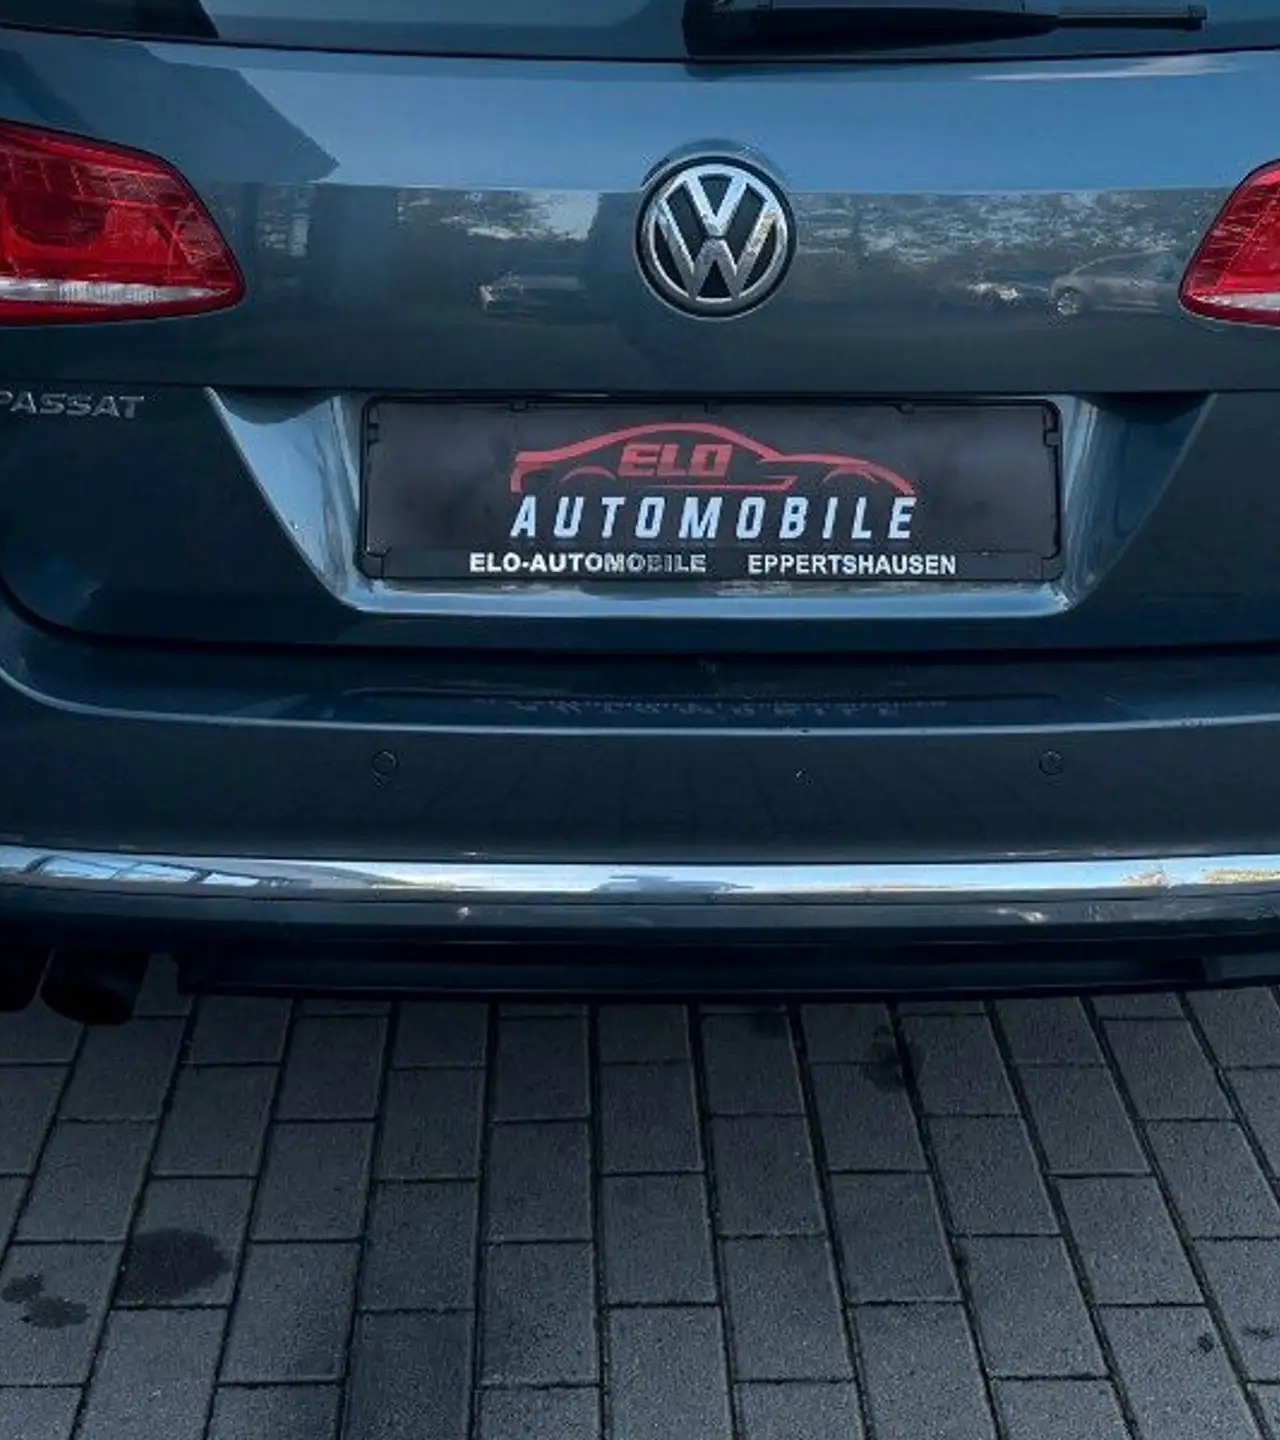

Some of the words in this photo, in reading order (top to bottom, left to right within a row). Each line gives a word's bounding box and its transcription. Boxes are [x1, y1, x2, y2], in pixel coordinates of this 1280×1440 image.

[646, 162, 788, 305] VW
[617, 443, 733, 477] ELO
[510, 495, 918, 540] AUTOMOBILE
[469, 551, 707, 574] ELO-AUTOMOBILE
[747, 553, 957, 576] EPPERTSHAUSEN
